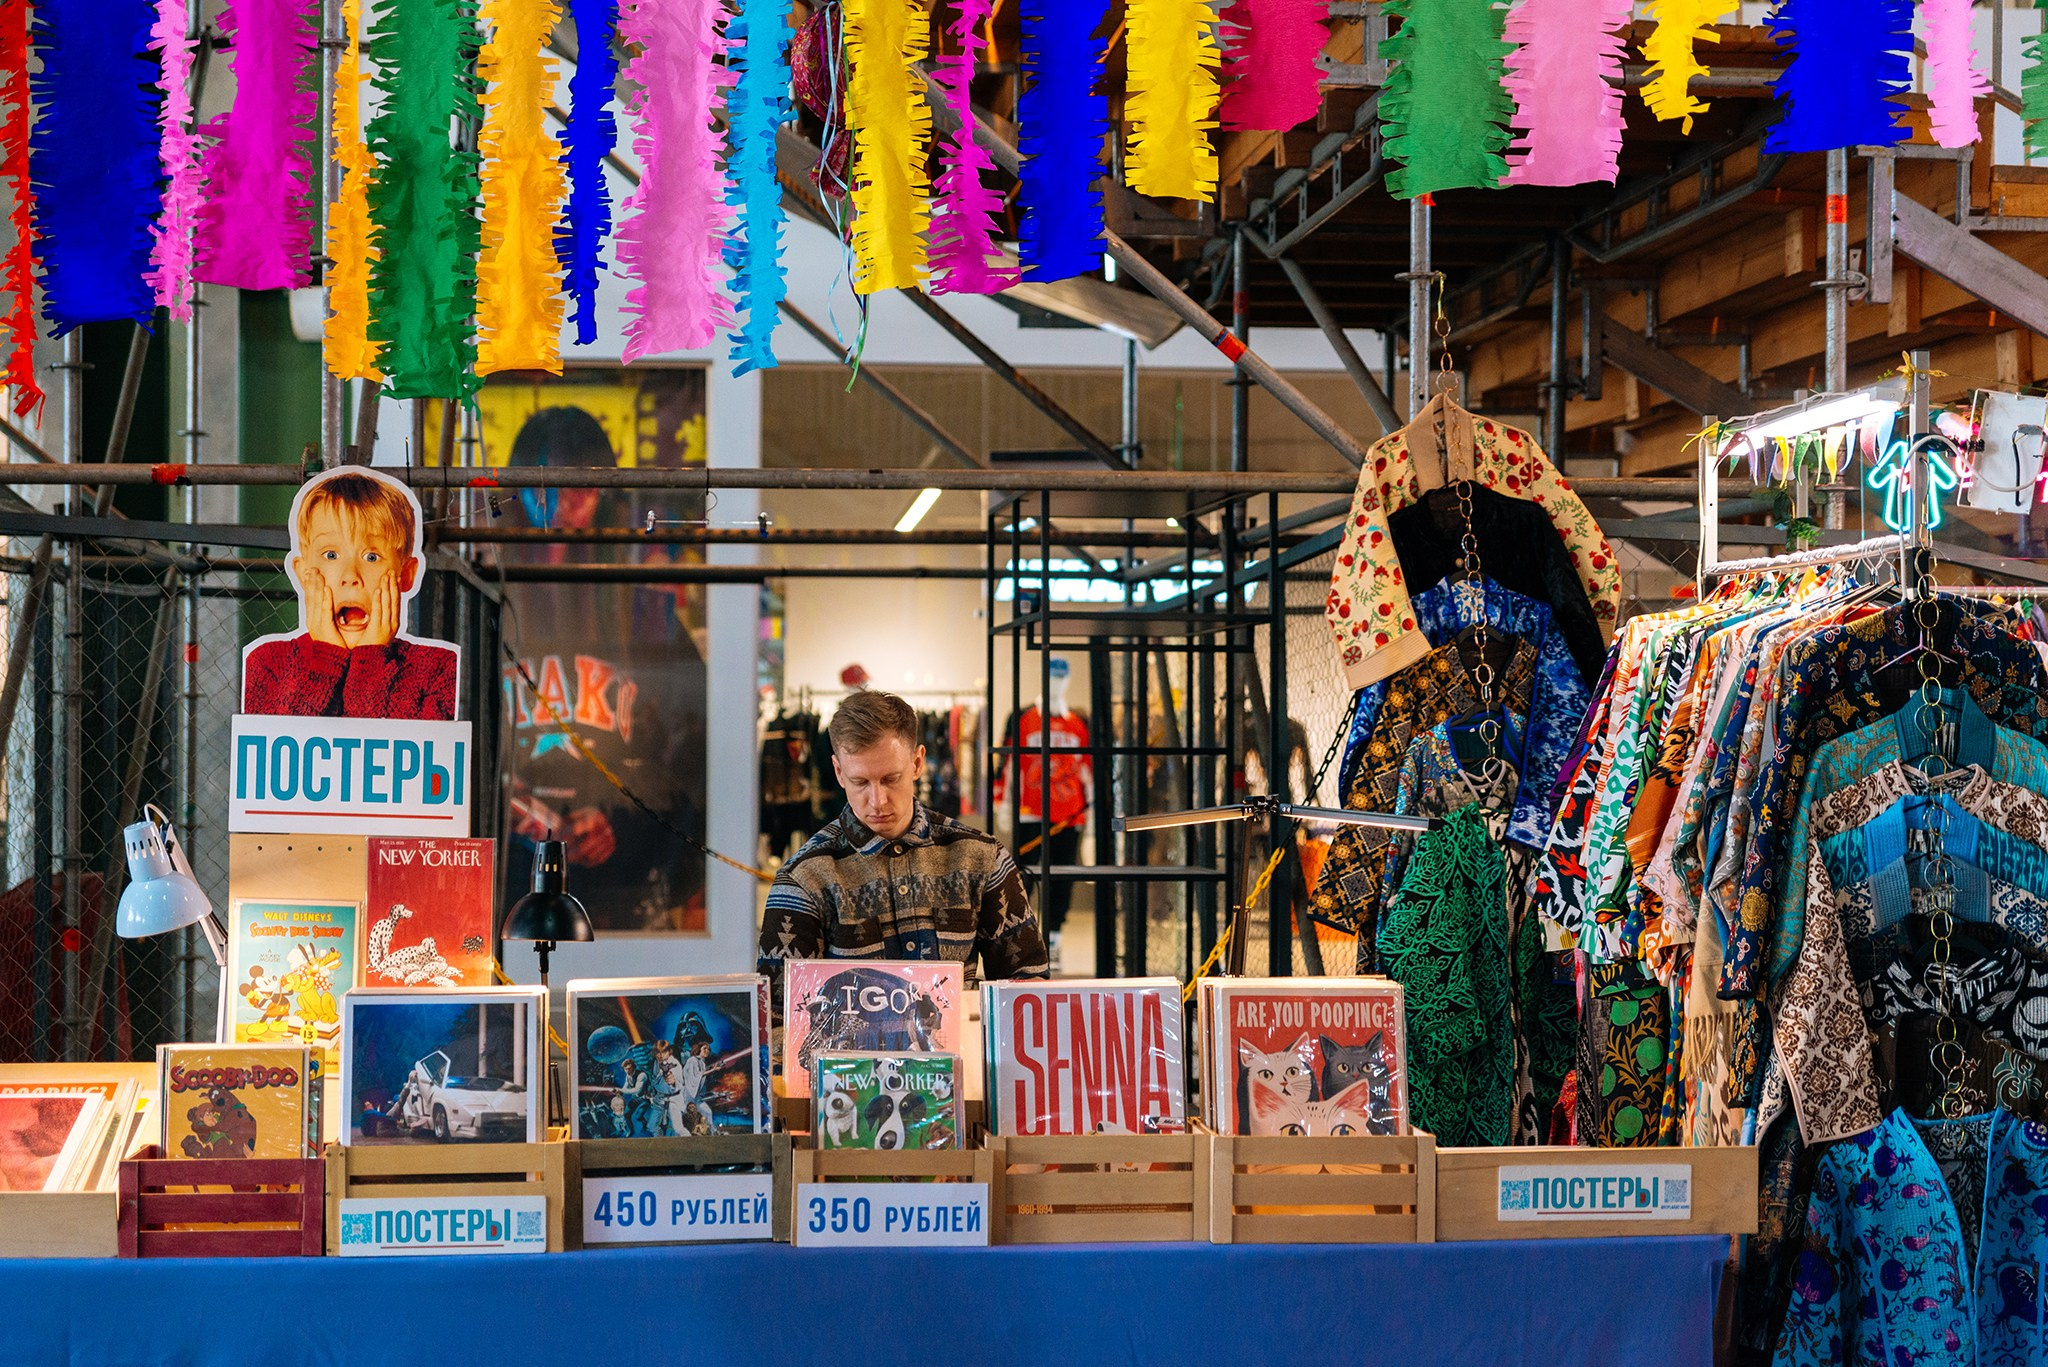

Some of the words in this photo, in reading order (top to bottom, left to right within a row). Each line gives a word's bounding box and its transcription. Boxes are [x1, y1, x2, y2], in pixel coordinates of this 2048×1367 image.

[236, 734, 465, 806] ПОСТЕРЫ
[379, 849, 416, 866] NEW
[419, 849, 482, 866] YORKER
[418, 840, 436, 848] THE
[263, 911, 288, 921] WALT
[292, 912, 332, 922] DISNEY'S
[312, 924, 344, 939] SHOW
[840, 981, 923, 1015] IGOR
[1236, 1001, 1267, 1028] ARE
[1272, 1001, 1304, 1028] YOU
[1310, 1001, 1388, 1028] POOPING?
[303, 1030, 314, 1040] 13
[1012, 992, 1172, 1136] SENNA
[837, 1074, 870, 1091] NEW
[873, 1072, 944, 1091] YORKER
[1532, 1177, 1659, 1209] ПОСТЕРЫ
[593, 1191, 657, 1227] 450
[671, 1192, 768, 1226] РУБЛЕЙ
[809, 1197, 871, 1233] 350
[885, 1201, 981, 1233] РУБЛЕЙ
[1018, 1204, 1053, 1215] 1960-1994
[375, 1208, 511, 1243] ПОСТЕРЫ
